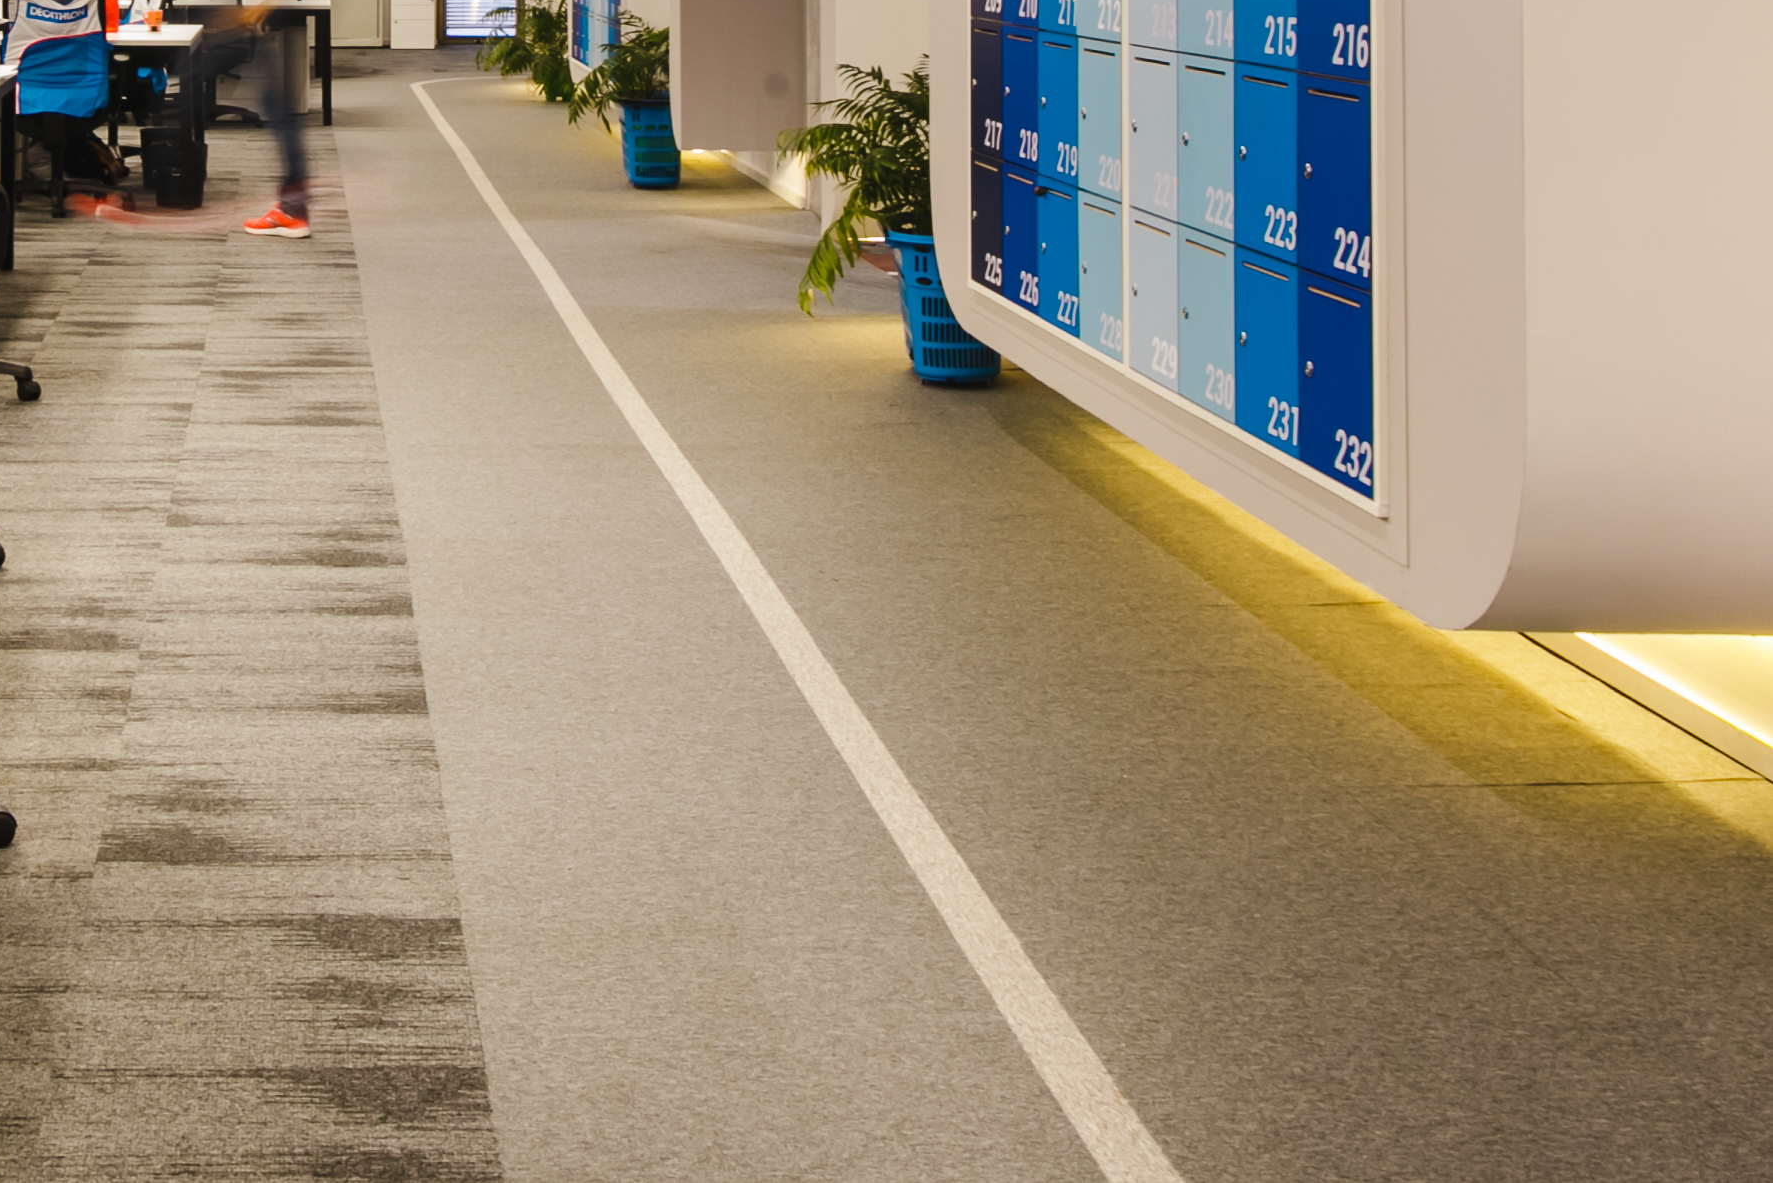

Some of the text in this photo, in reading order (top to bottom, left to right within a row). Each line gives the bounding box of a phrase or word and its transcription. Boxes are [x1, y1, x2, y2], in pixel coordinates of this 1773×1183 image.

[29, 6, 85, 20] DECATHLON
[1151, 4, 1177, 40] 213
[1205, 10, 1234, 48] 214
[1264, 16, 1297, 57] 215
[1332, 23, 1369, 68] 216
[984, 119, 1002, 150] 217
[1020, 129, 1038, 162] 218
[1057, 142, 1078, 177] 219
[1098, 155, 1121, 192] 220
[1154, 171, 1177, 210] 221
[1205, 186, 1234, 229] 222
[1264, 205, 1297, 251] 223
[984, 252, 1002, 287] 225
[1334, 227, 1371, 278] 224
[1020, 271, 1039, 306] 226
[1057, 291, 1078, 327] 227
[1100, 312, 1123, 352] 228
[1152, 336, 1177, 379] 229
[1205, 363, 1235, 411] 230
[1267, 397, 1299, 446] 231
[1334, 429, 1372, 487] 232
